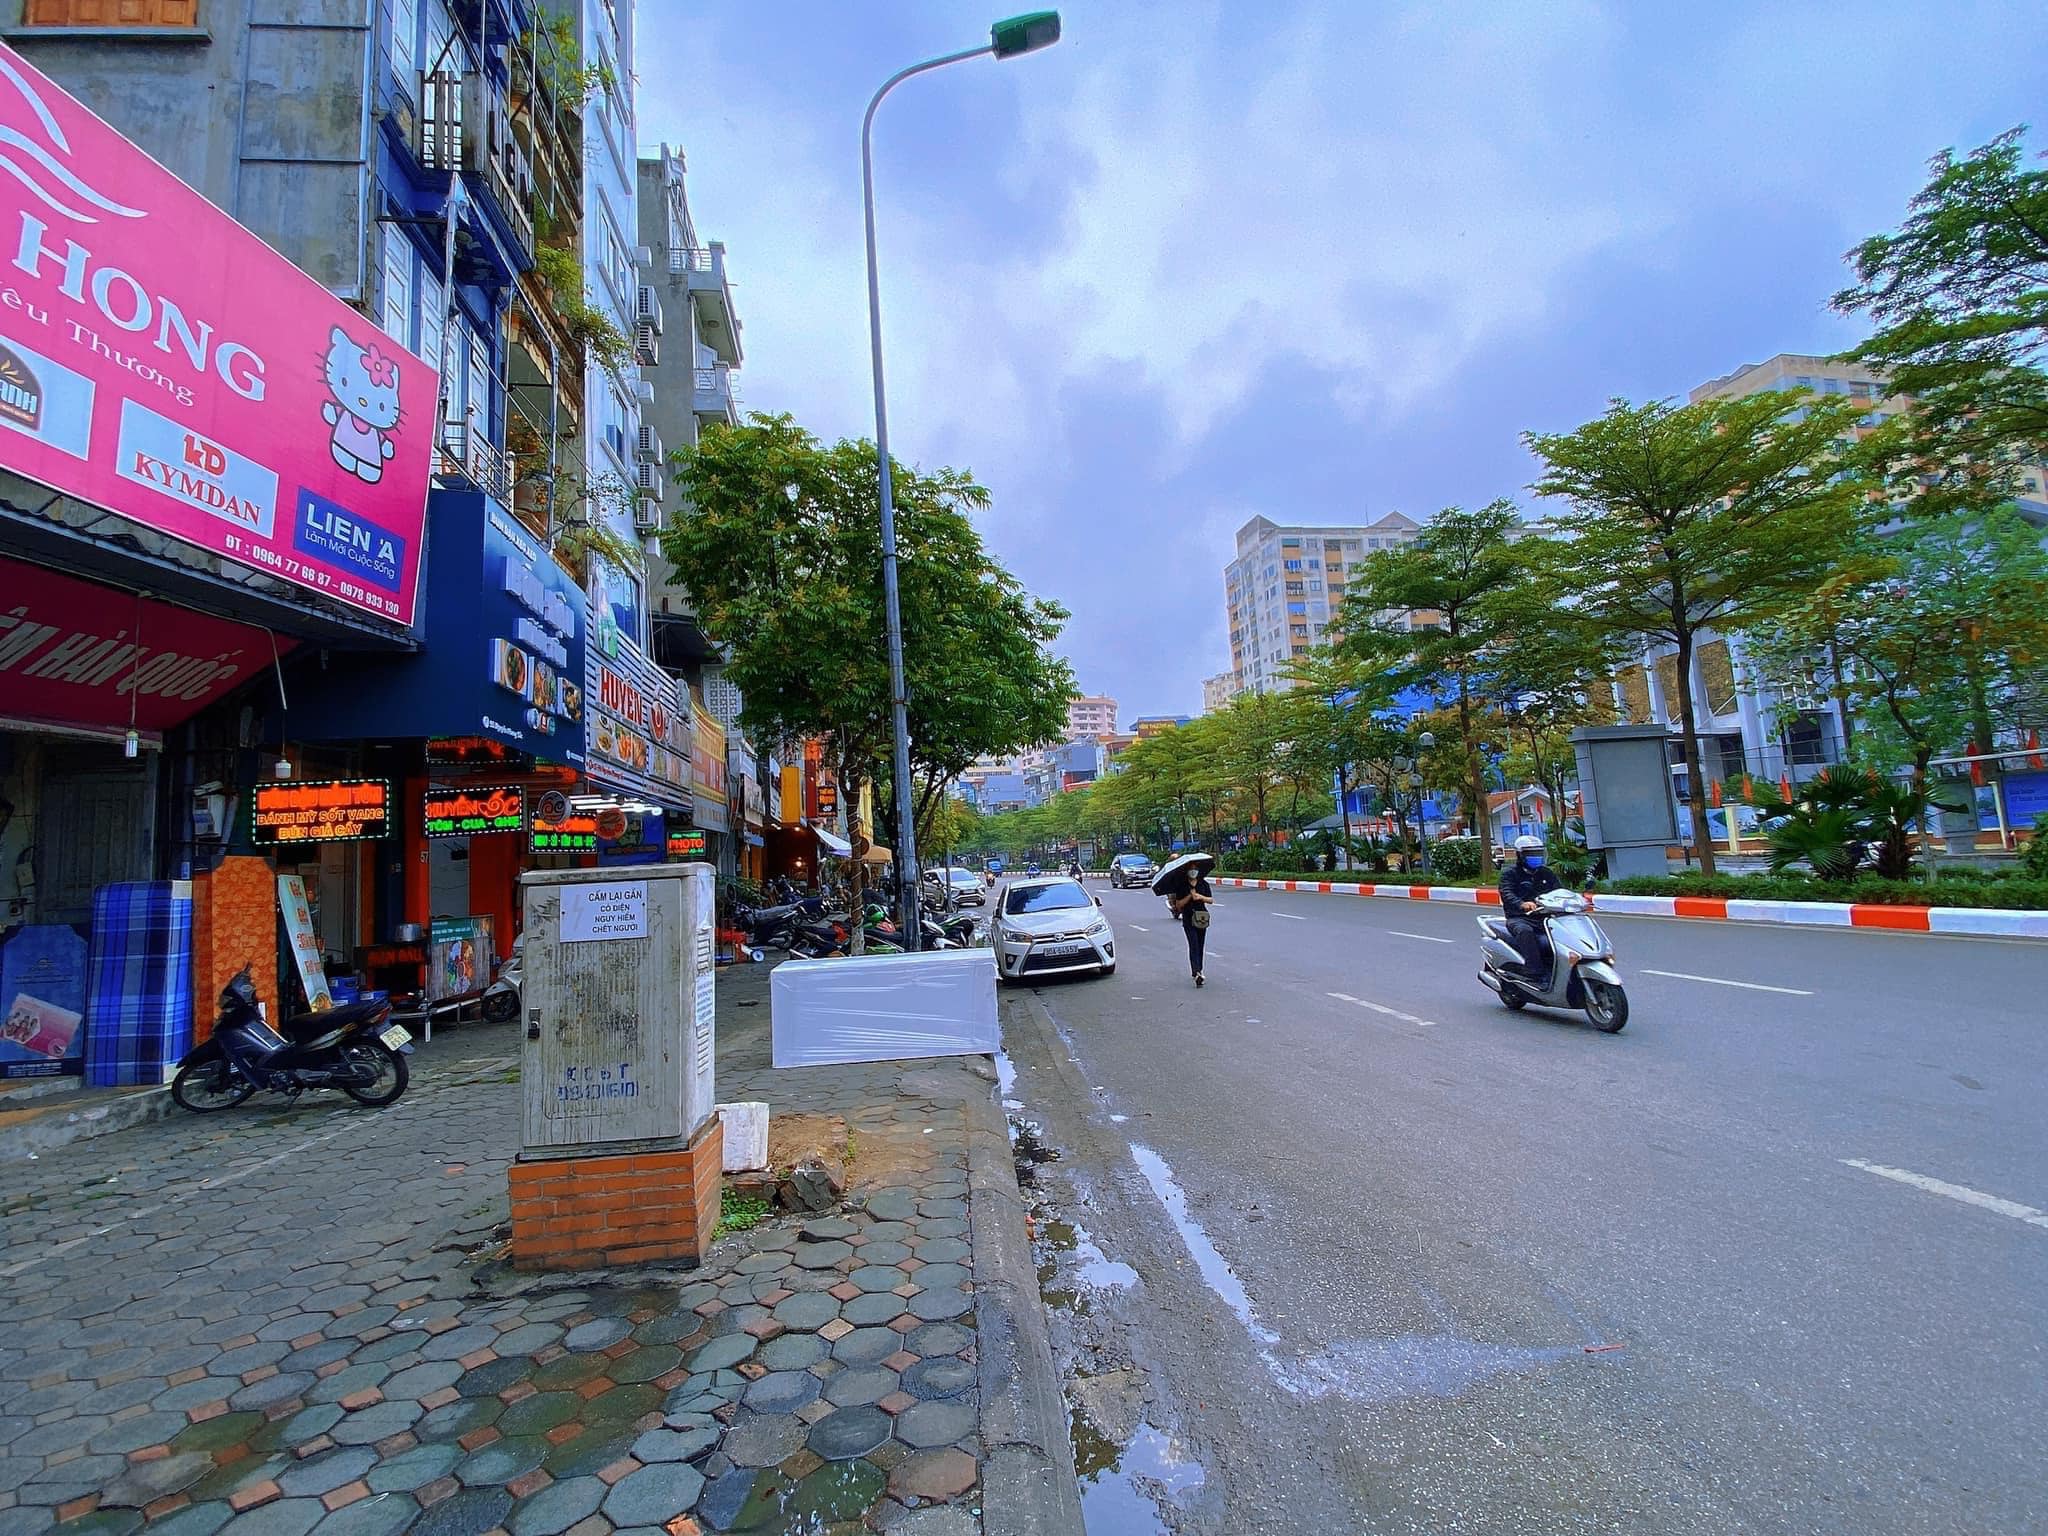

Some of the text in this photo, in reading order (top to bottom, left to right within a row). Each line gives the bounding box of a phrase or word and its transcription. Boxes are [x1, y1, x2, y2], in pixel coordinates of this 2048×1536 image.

[11, 209, 266, 402] HONG
[0, 283, 195, 407] êu Thương
[134, 450, 261, 526] KYMDAN
[306, 502, 371, 552] LIEN
[252, 545, 282, 568] 0964
[285, 558, 300, 574] 77
[301, 565, 316, 581] 66
[317, 571, 331, 587] 87
[340, 581, 364, 601] 0978
[385, 600, 399, 616] 130
[347, 548, 373, 568] Cuộc
[373, 559, 395, 580] Sống
[318, 806, 345, 822] SỐT
[346, 808, 385, 820] VANG
[668, 838, 704, 849] PHOTO
[594, 915, 616, 923] NGUY
